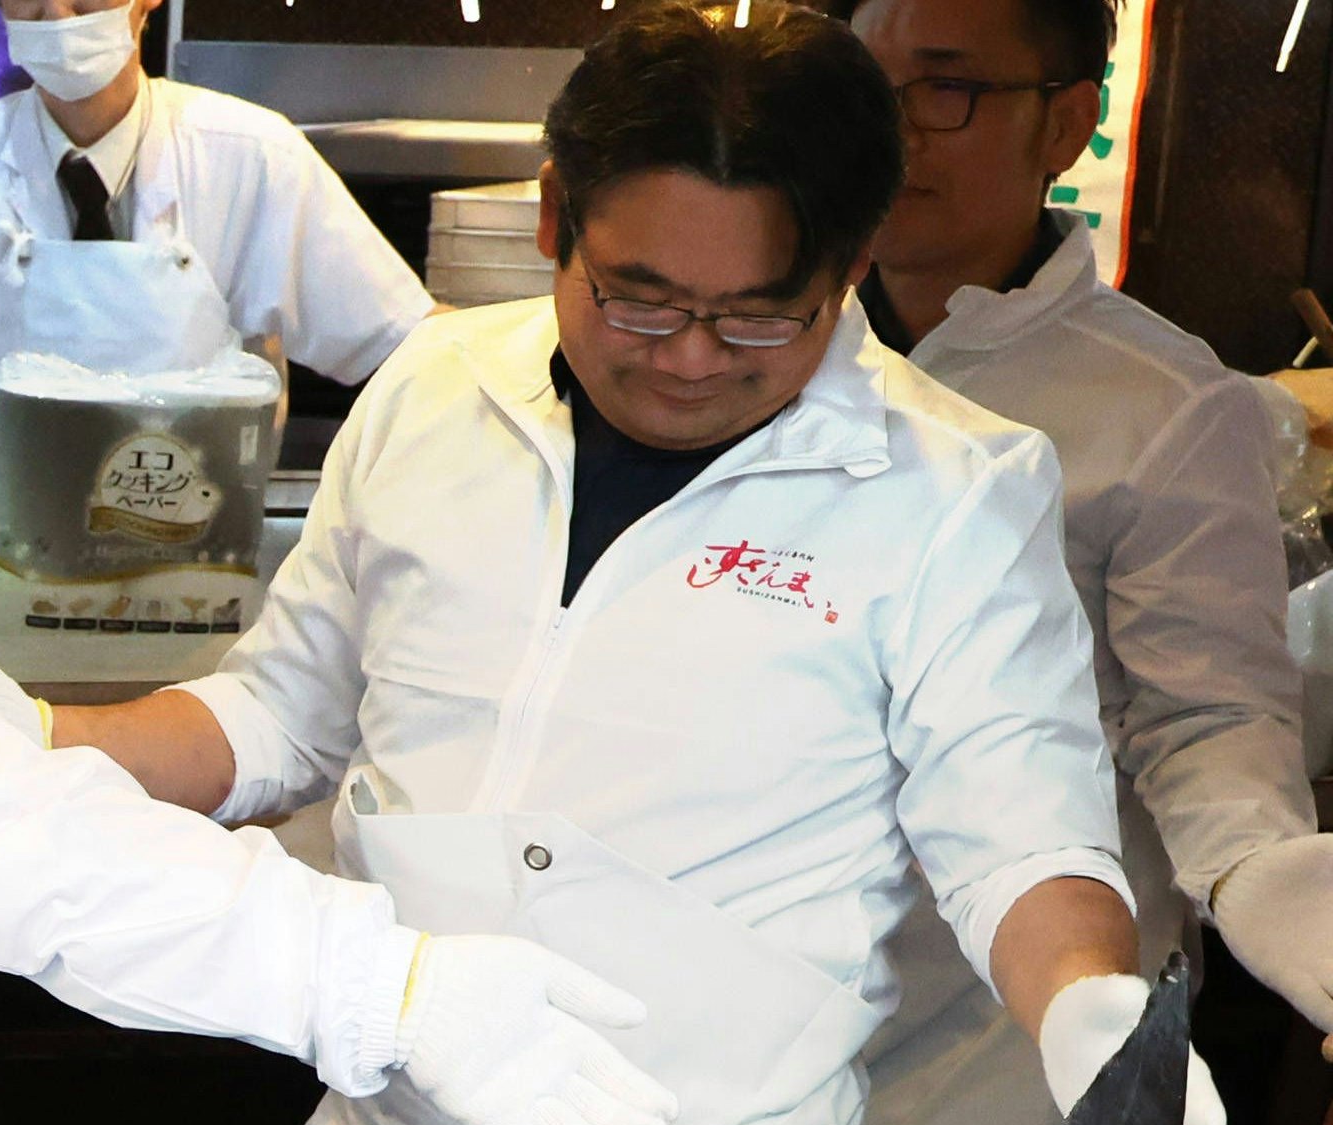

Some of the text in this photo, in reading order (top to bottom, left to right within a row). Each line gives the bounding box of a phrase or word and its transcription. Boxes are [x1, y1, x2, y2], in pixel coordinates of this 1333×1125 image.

[129, 451, 173, 470] エコ
[108, 470, 194, 493] クッキング
